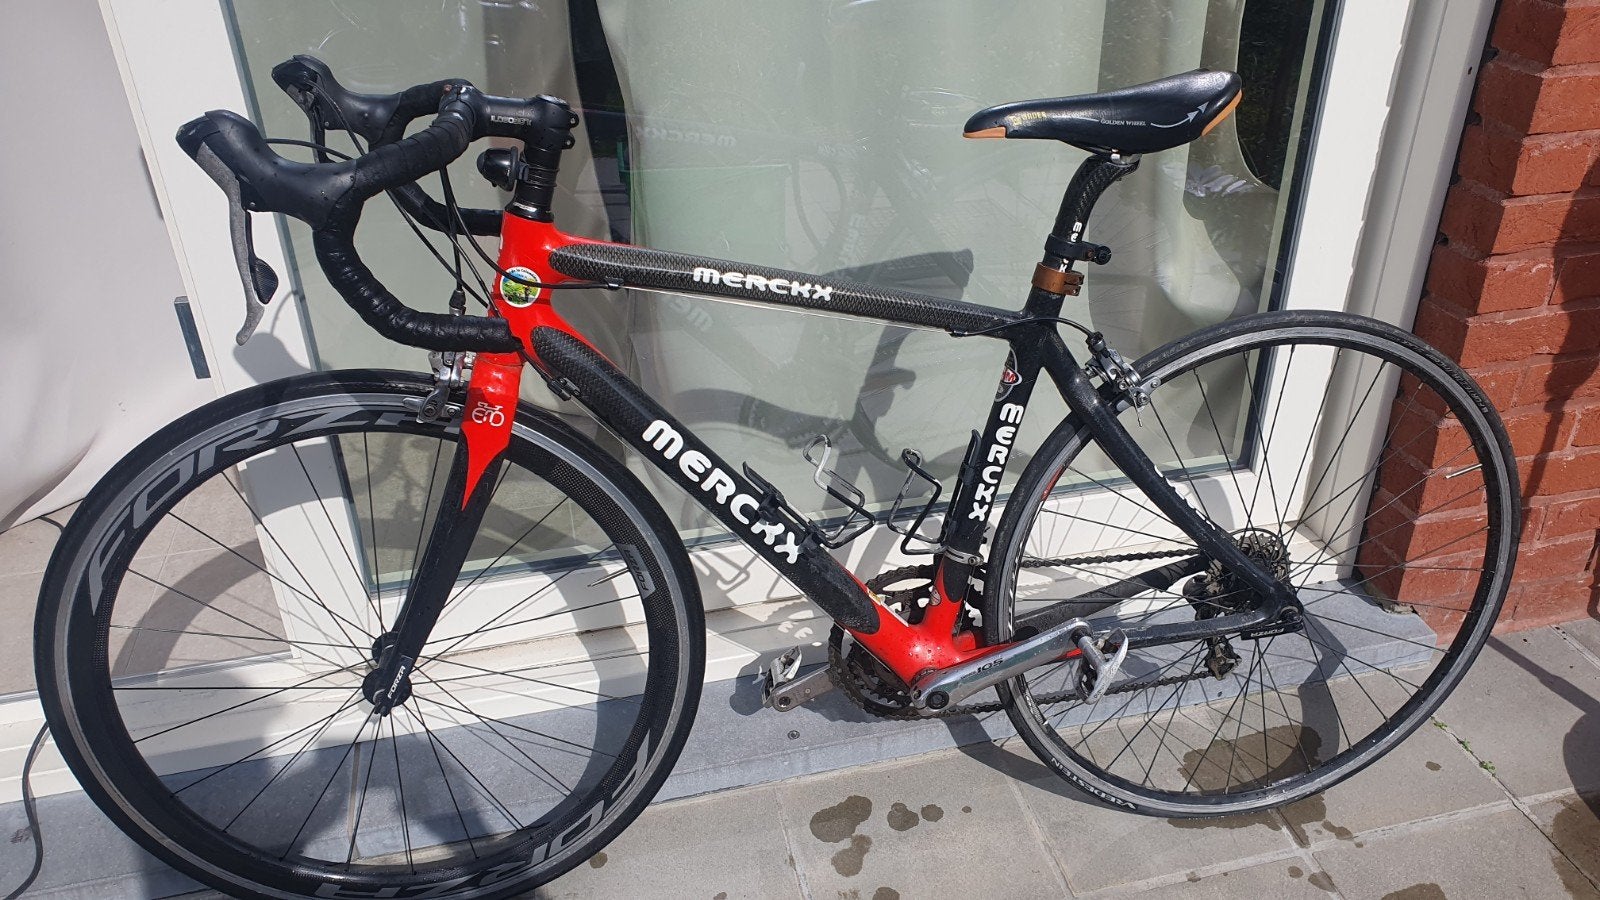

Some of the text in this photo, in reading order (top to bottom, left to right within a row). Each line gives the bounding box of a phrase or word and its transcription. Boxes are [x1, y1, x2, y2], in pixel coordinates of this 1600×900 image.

[693, 267, 833, 302] MERCKX
[968, 402, 1024, 522] MERCKX
[642, 419, 802, 565] MERCKX
[387, 665, 406, 699] FORZA
[977, 657, 1004, 673] 105
[1050, 757, 1137, 810] VREDESTEIN
